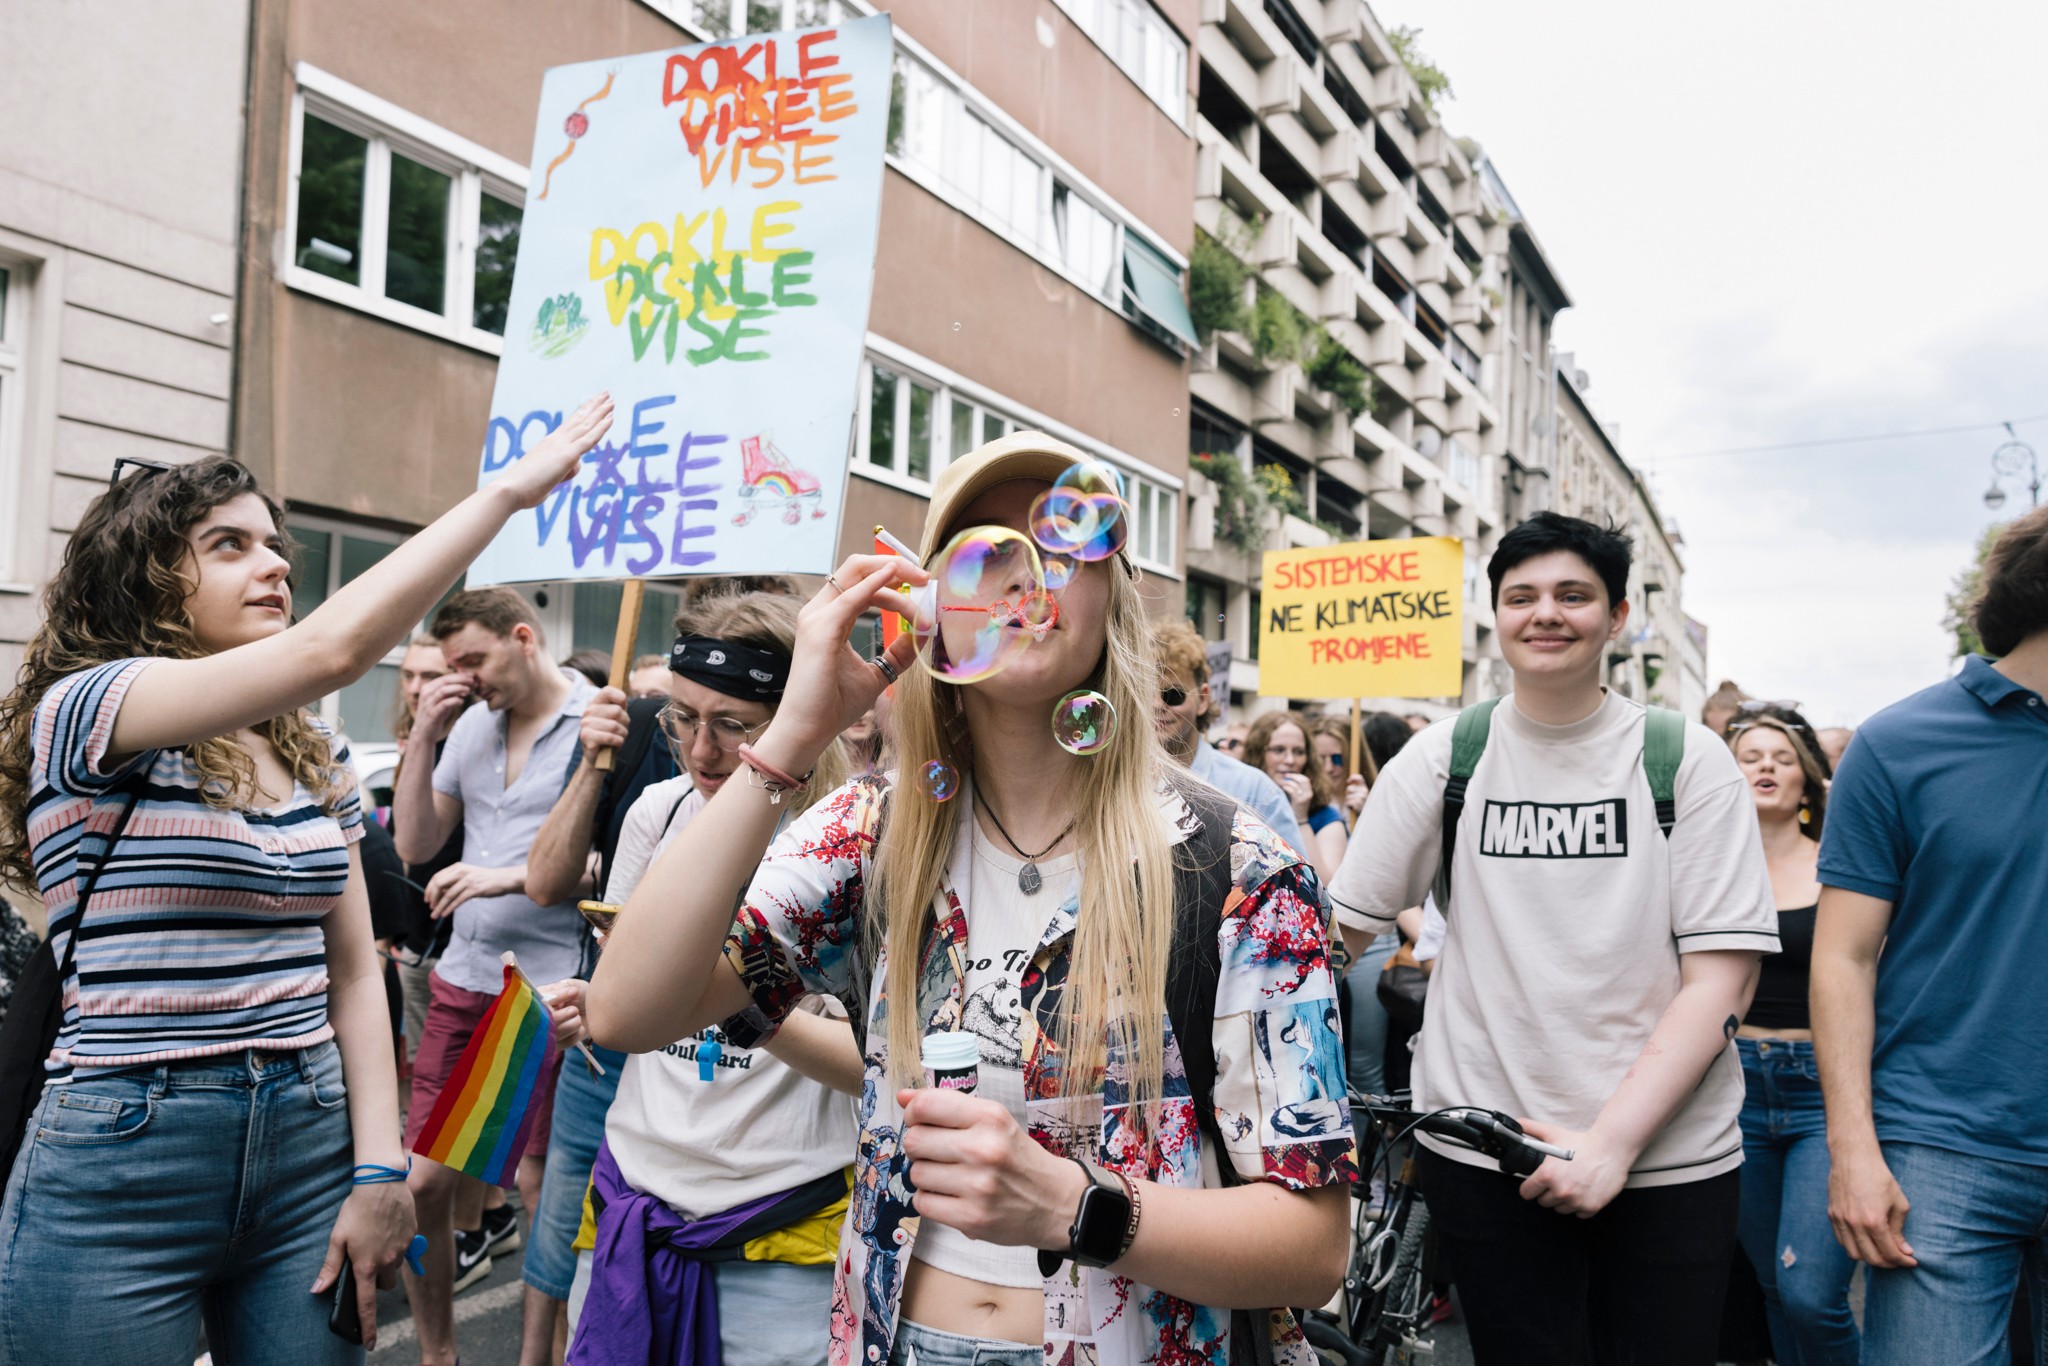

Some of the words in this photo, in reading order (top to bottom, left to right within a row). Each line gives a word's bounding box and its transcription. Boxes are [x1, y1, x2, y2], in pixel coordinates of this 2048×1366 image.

[662, 29, 840, 108] DOKLE
[683, 73, 858, 134] DOKLE
[699, 134, 841, 191] VISE
[588, 200, 804, 281] DOKLE
[616, 250, 819, 308] DOKLE
[629, 302, 781, 367] VISE
[483, 395, 677, 473] DOE
[571, 495, 719, 576] VISE
[1273, 551, 1421, 590] SISTEMSKE
[1269, 604, 1304, 633] NE
[1316, 590, 1453, 631] KLIMATSKE
[1309, 632, 1432, 665] PROMJENE
[1482, 802, 1625, 856] MARVEL
[939, 1075, 977, 1090] MINNI
